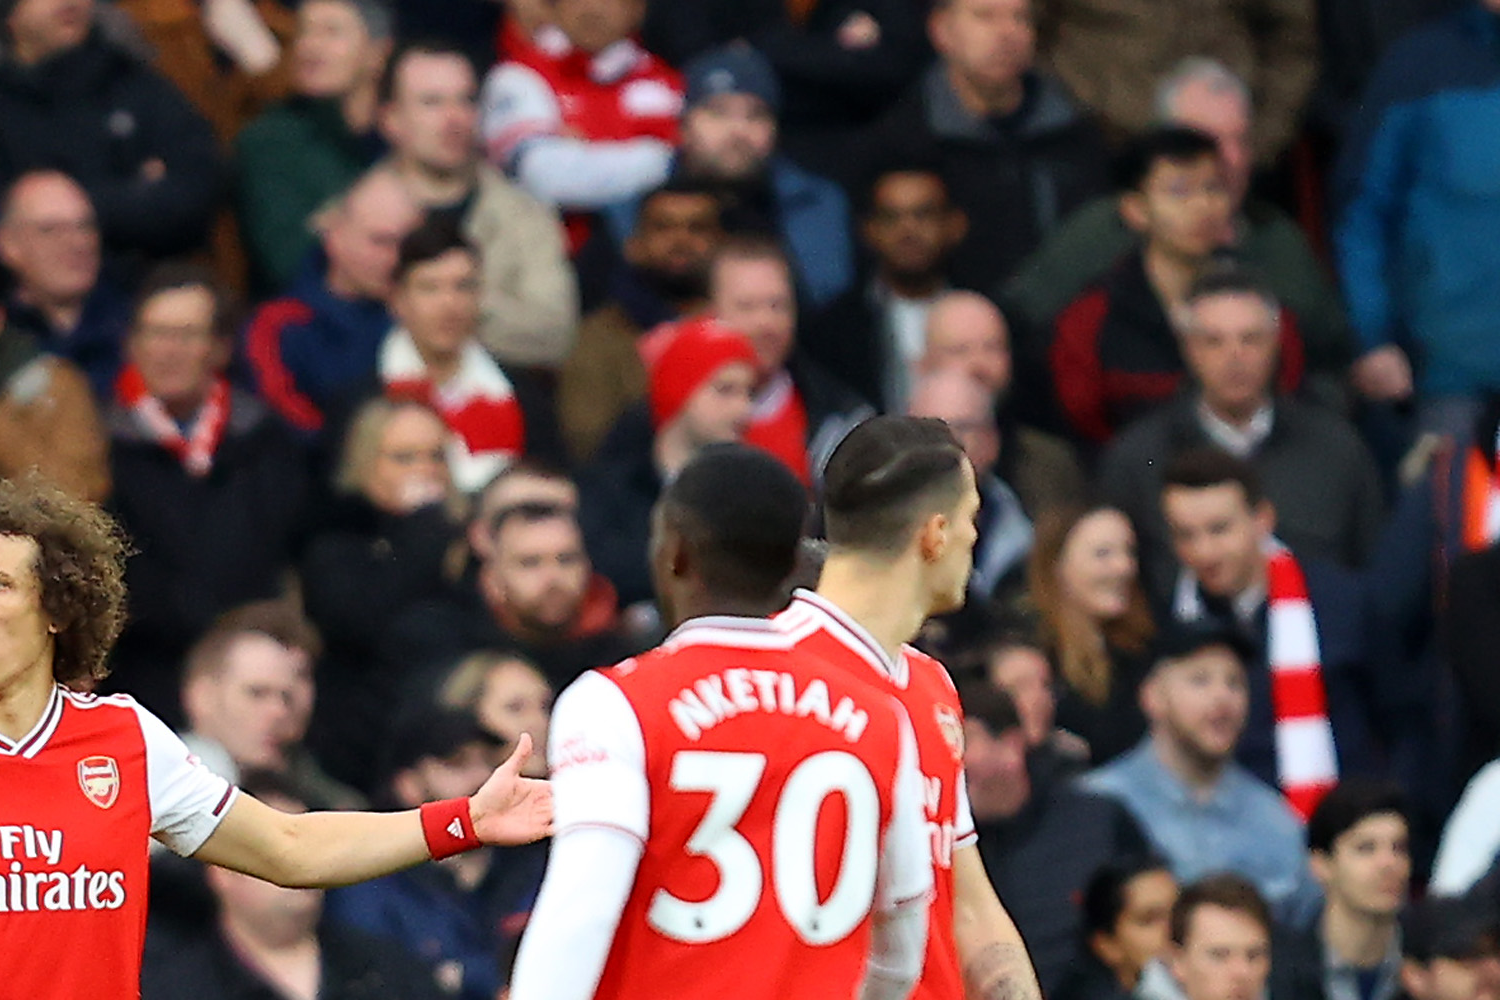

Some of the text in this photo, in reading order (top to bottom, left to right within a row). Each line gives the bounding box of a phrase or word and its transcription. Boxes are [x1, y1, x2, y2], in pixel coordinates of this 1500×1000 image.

[668, 667, 869, 743] NKETIAH
[0, 825, 63, 865] Fly
[646, 750, 881, 946] 30
